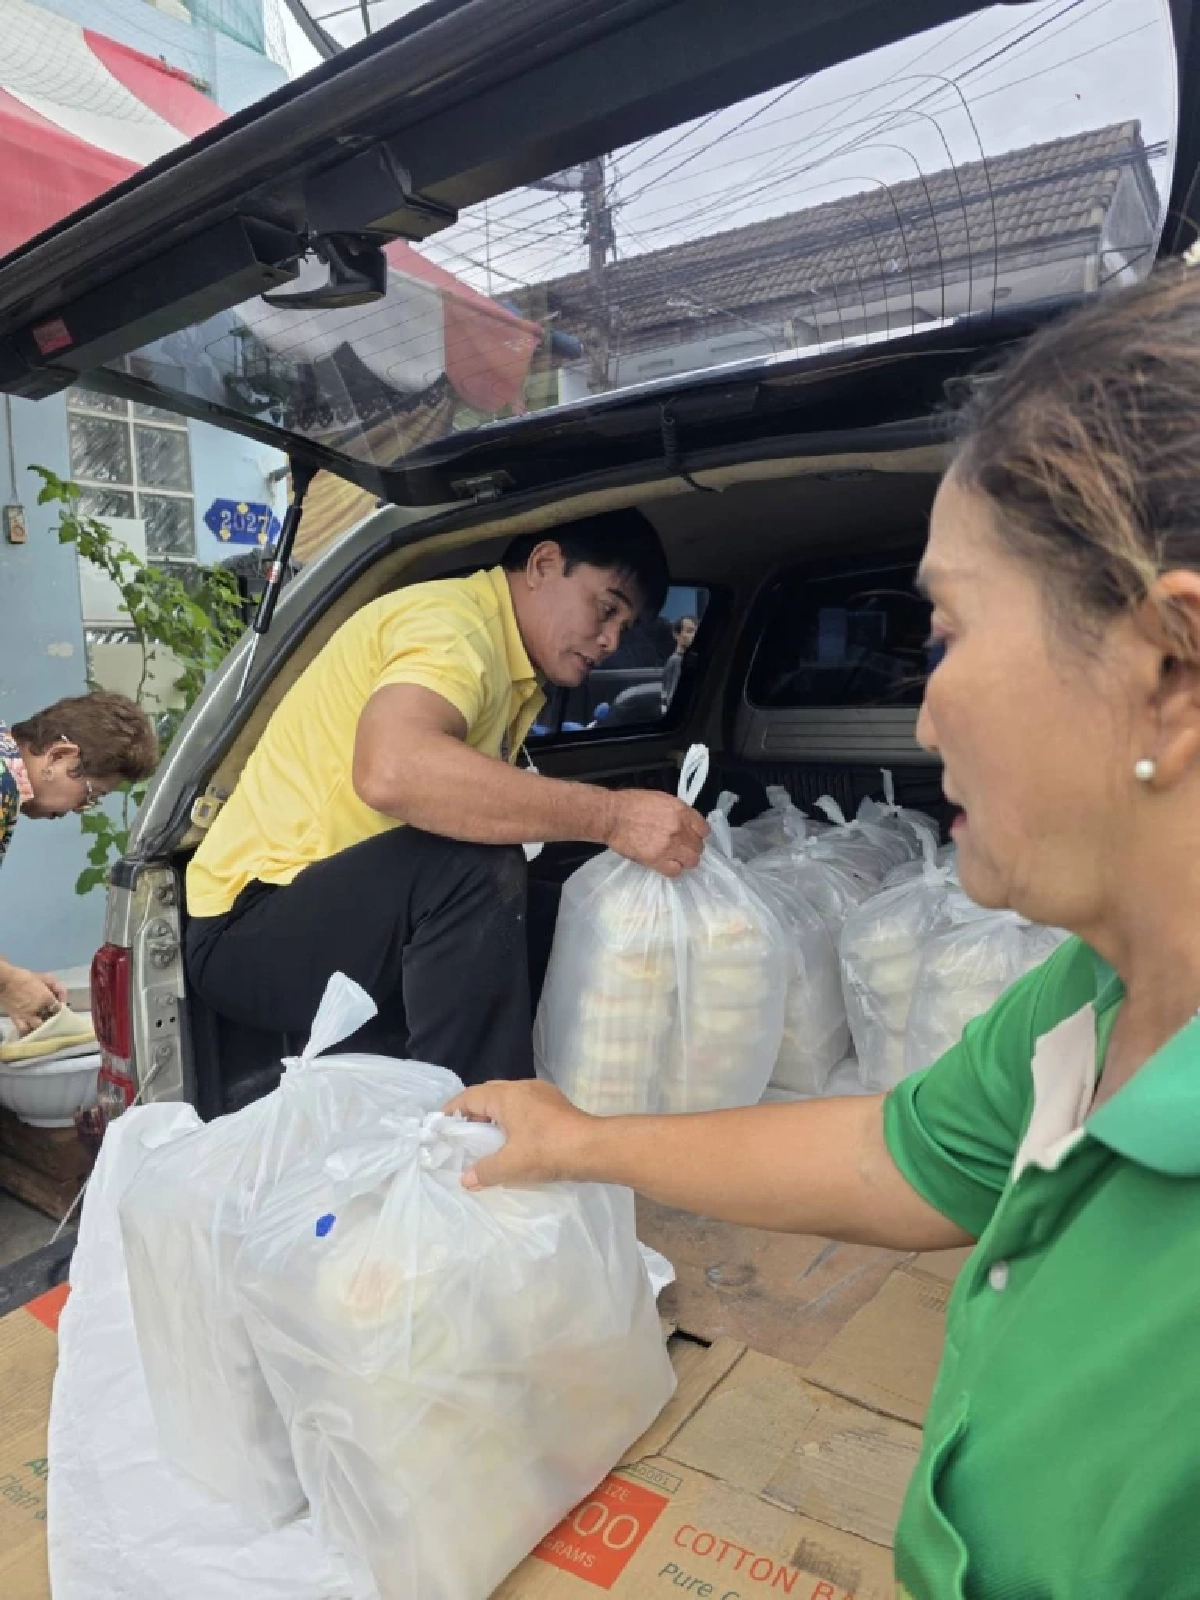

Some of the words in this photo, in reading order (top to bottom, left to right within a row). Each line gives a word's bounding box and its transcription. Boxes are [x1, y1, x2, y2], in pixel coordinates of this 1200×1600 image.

[221, 509, 269, 534] 2027
[564, 1502, 640, 1550] 00
[542, 1539, 596, 1568] GRAMS
[673, 1524, 799, 1595] COTTON
[657, 1561, 713, 1597] Pure
